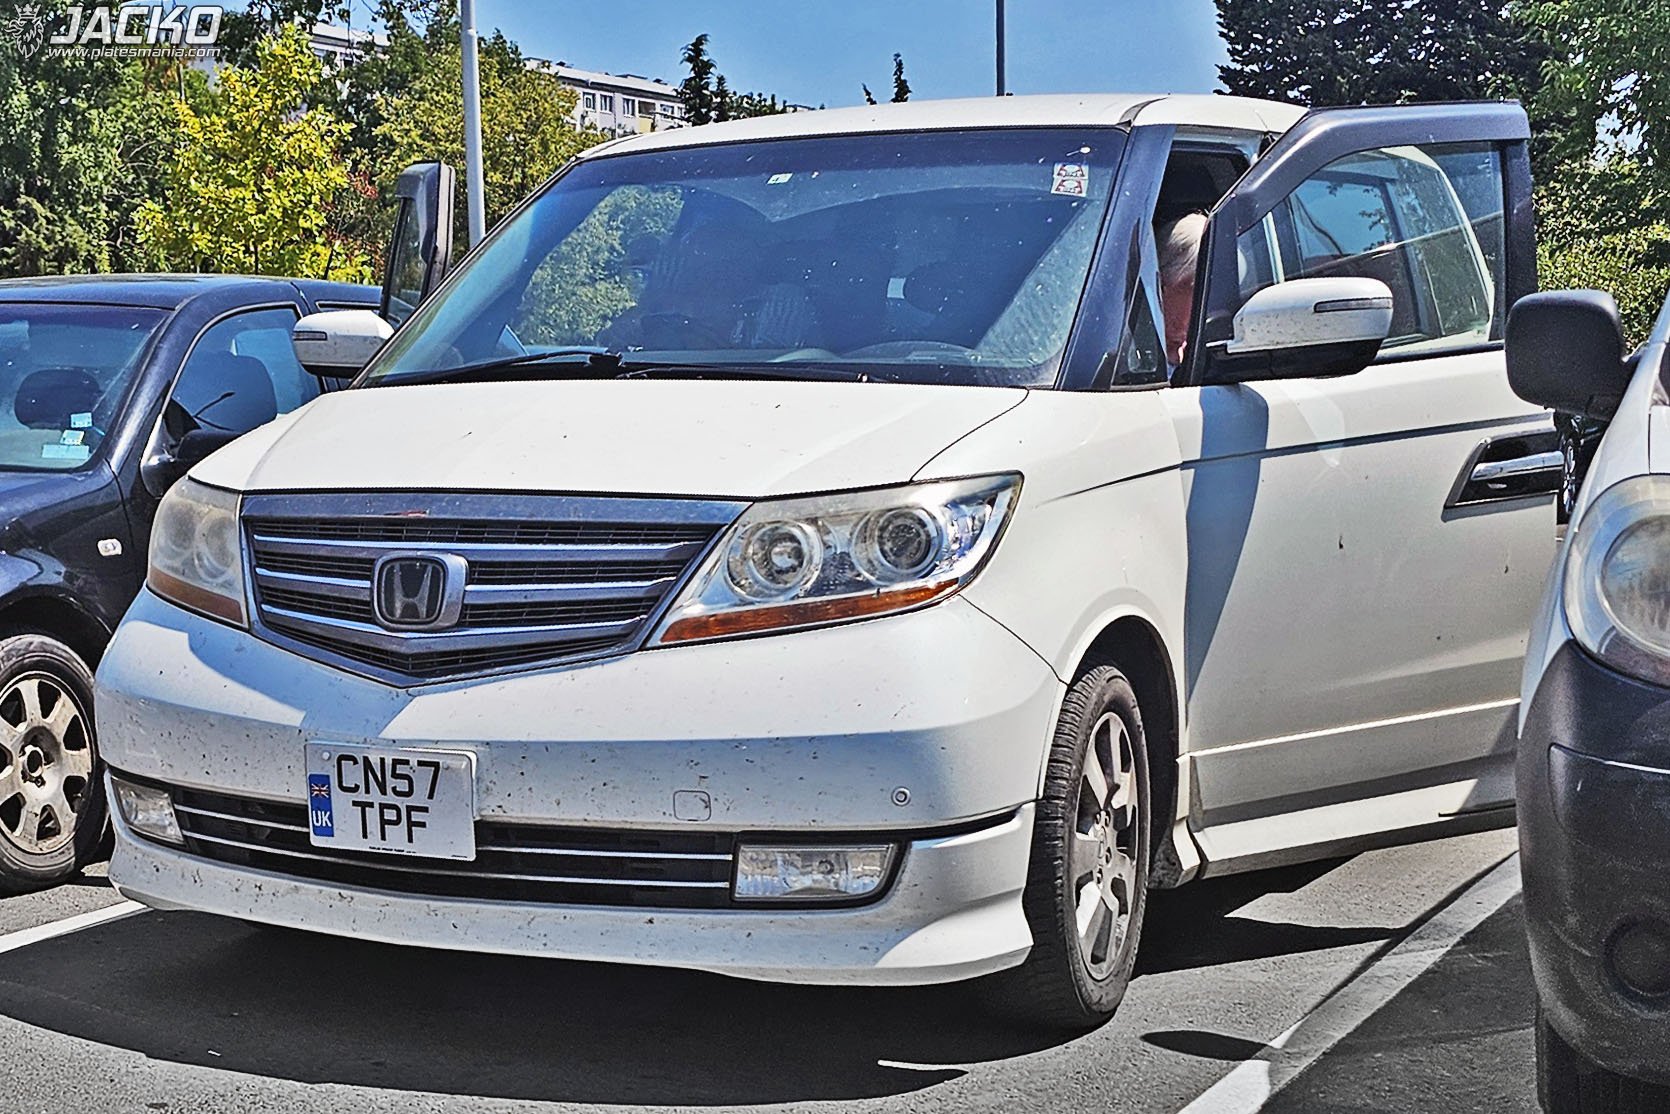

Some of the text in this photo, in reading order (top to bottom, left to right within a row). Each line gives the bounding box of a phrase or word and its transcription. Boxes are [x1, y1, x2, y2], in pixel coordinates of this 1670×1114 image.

[336, 754, 441, 800] CN57
[312, 810, 332, 828] UK
[351, 800, 430, 844] TPF
